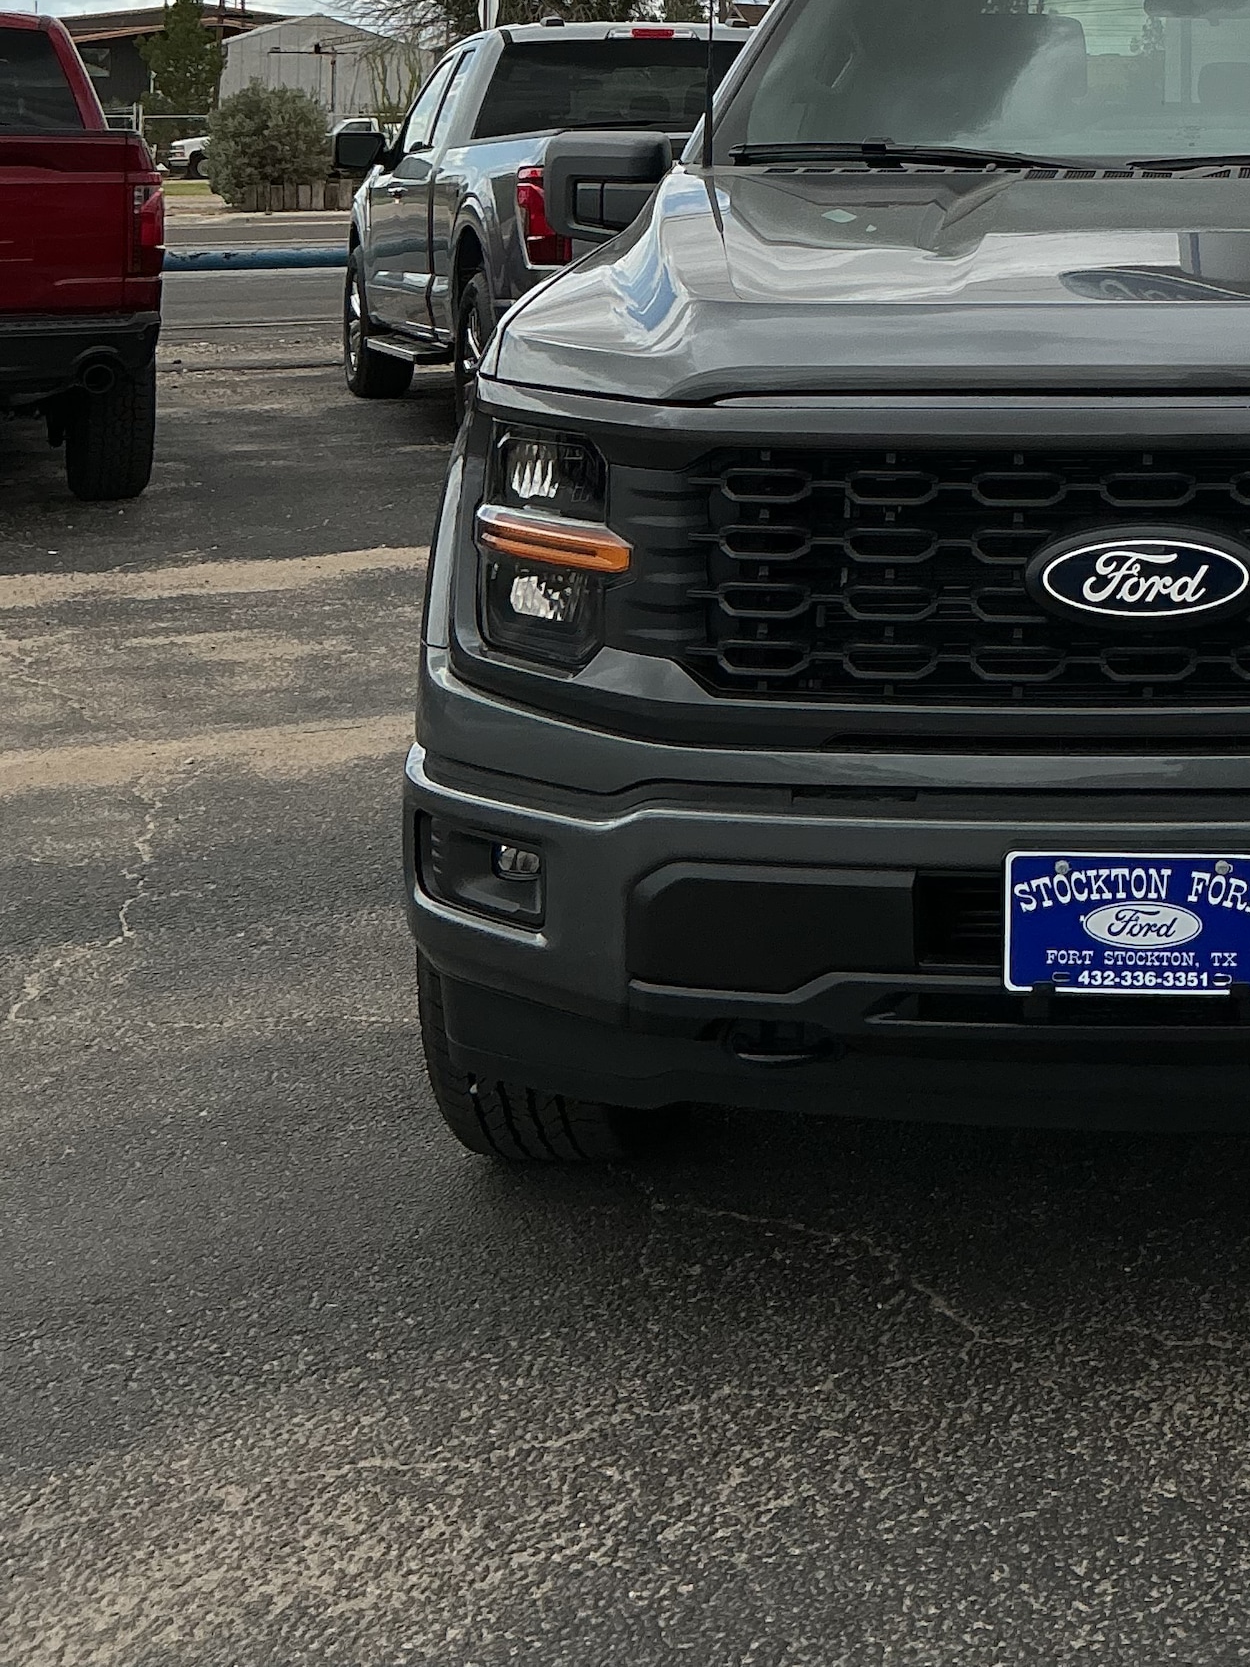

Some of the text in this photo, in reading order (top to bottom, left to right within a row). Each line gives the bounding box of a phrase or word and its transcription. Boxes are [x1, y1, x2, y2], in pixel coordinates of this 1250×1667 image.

[1082, 550, 1209, 603] Ford
[1013, 868, 1172, 913] STOCKTON
[1107, 908, 1178, 938] Ford
[1045, 950, 1238, 968] FORT STOCKTON, TX
[1077, 970, 1208, 987] 432-336-3351
